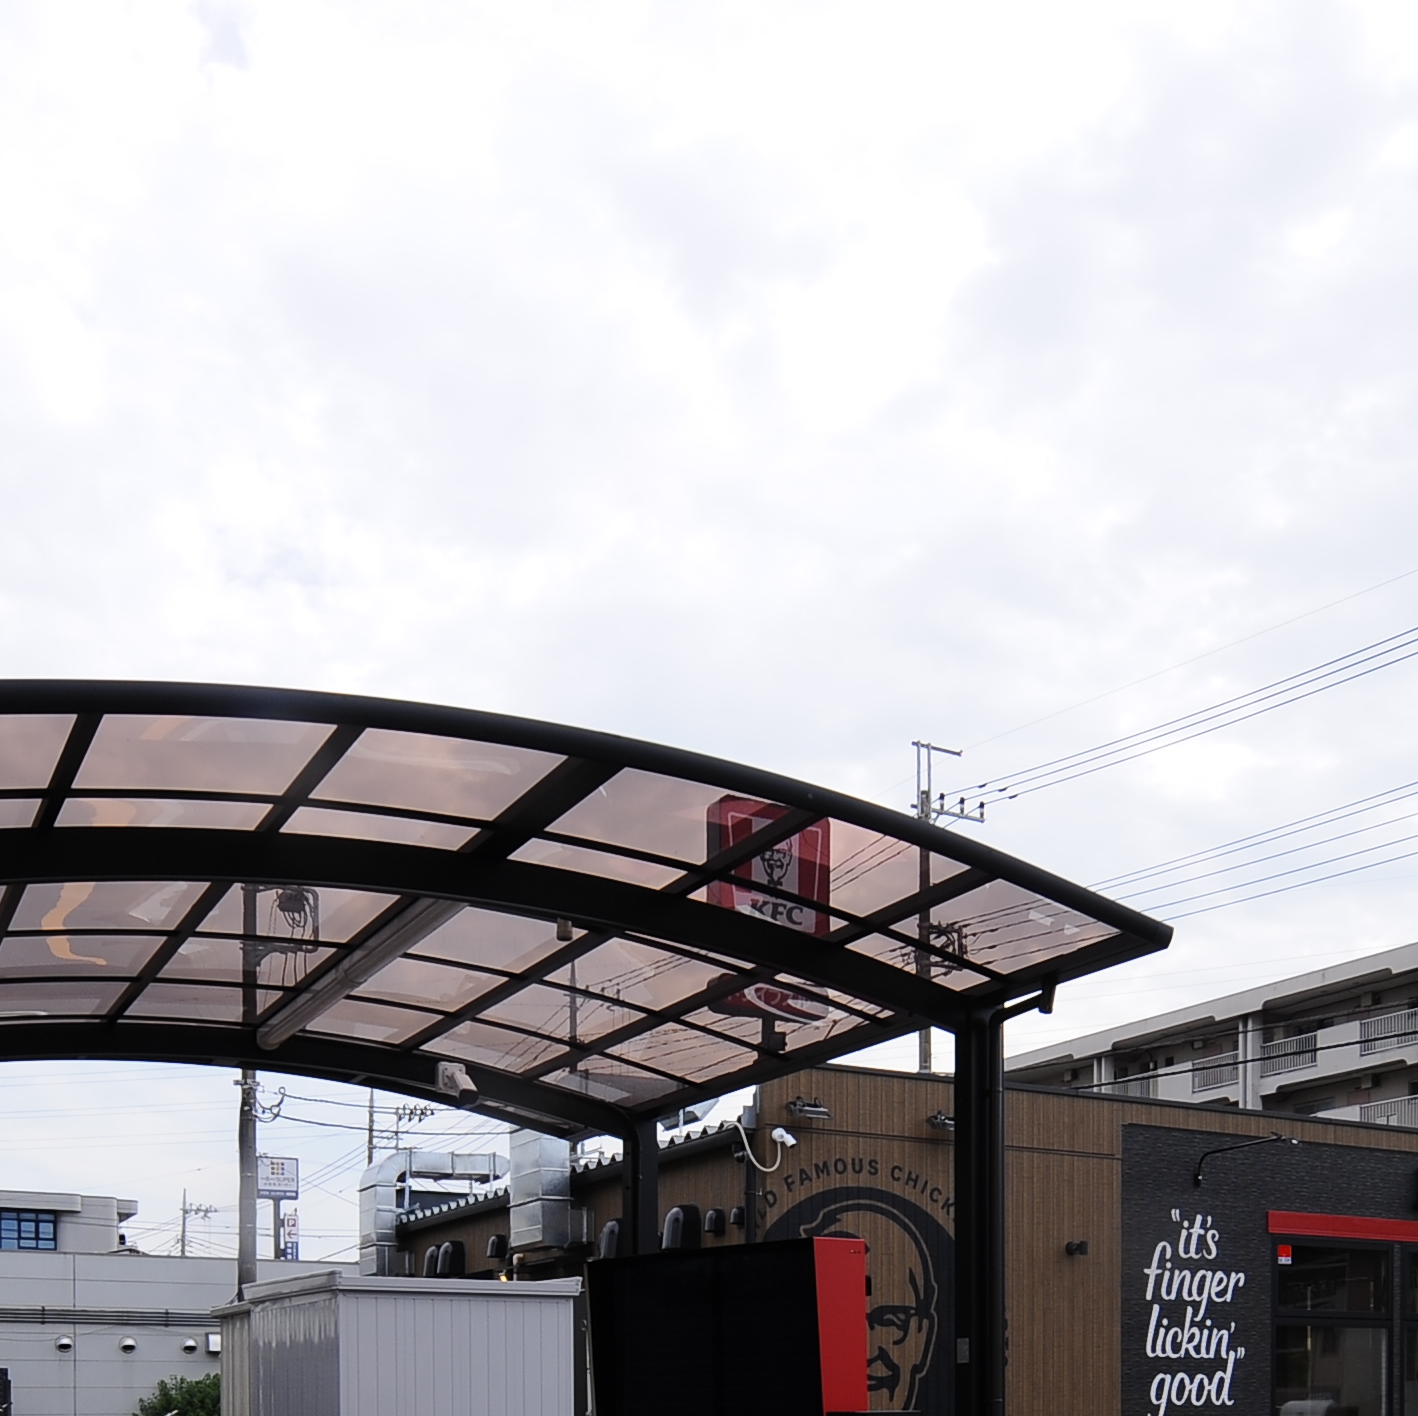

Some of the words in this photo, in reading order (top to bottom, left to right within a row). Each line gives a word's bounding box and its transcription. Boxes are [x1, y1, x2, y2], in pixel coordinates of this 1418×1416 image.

[750, 898, 804, 926] KFC
[784, 1157, 879, 1193] FAMOUS
[890, 1164, 955, 1220] CHICK
[1143, 1241, 1245, 1321] finger
[1146, 1303, 1236, 1358] lickin'
